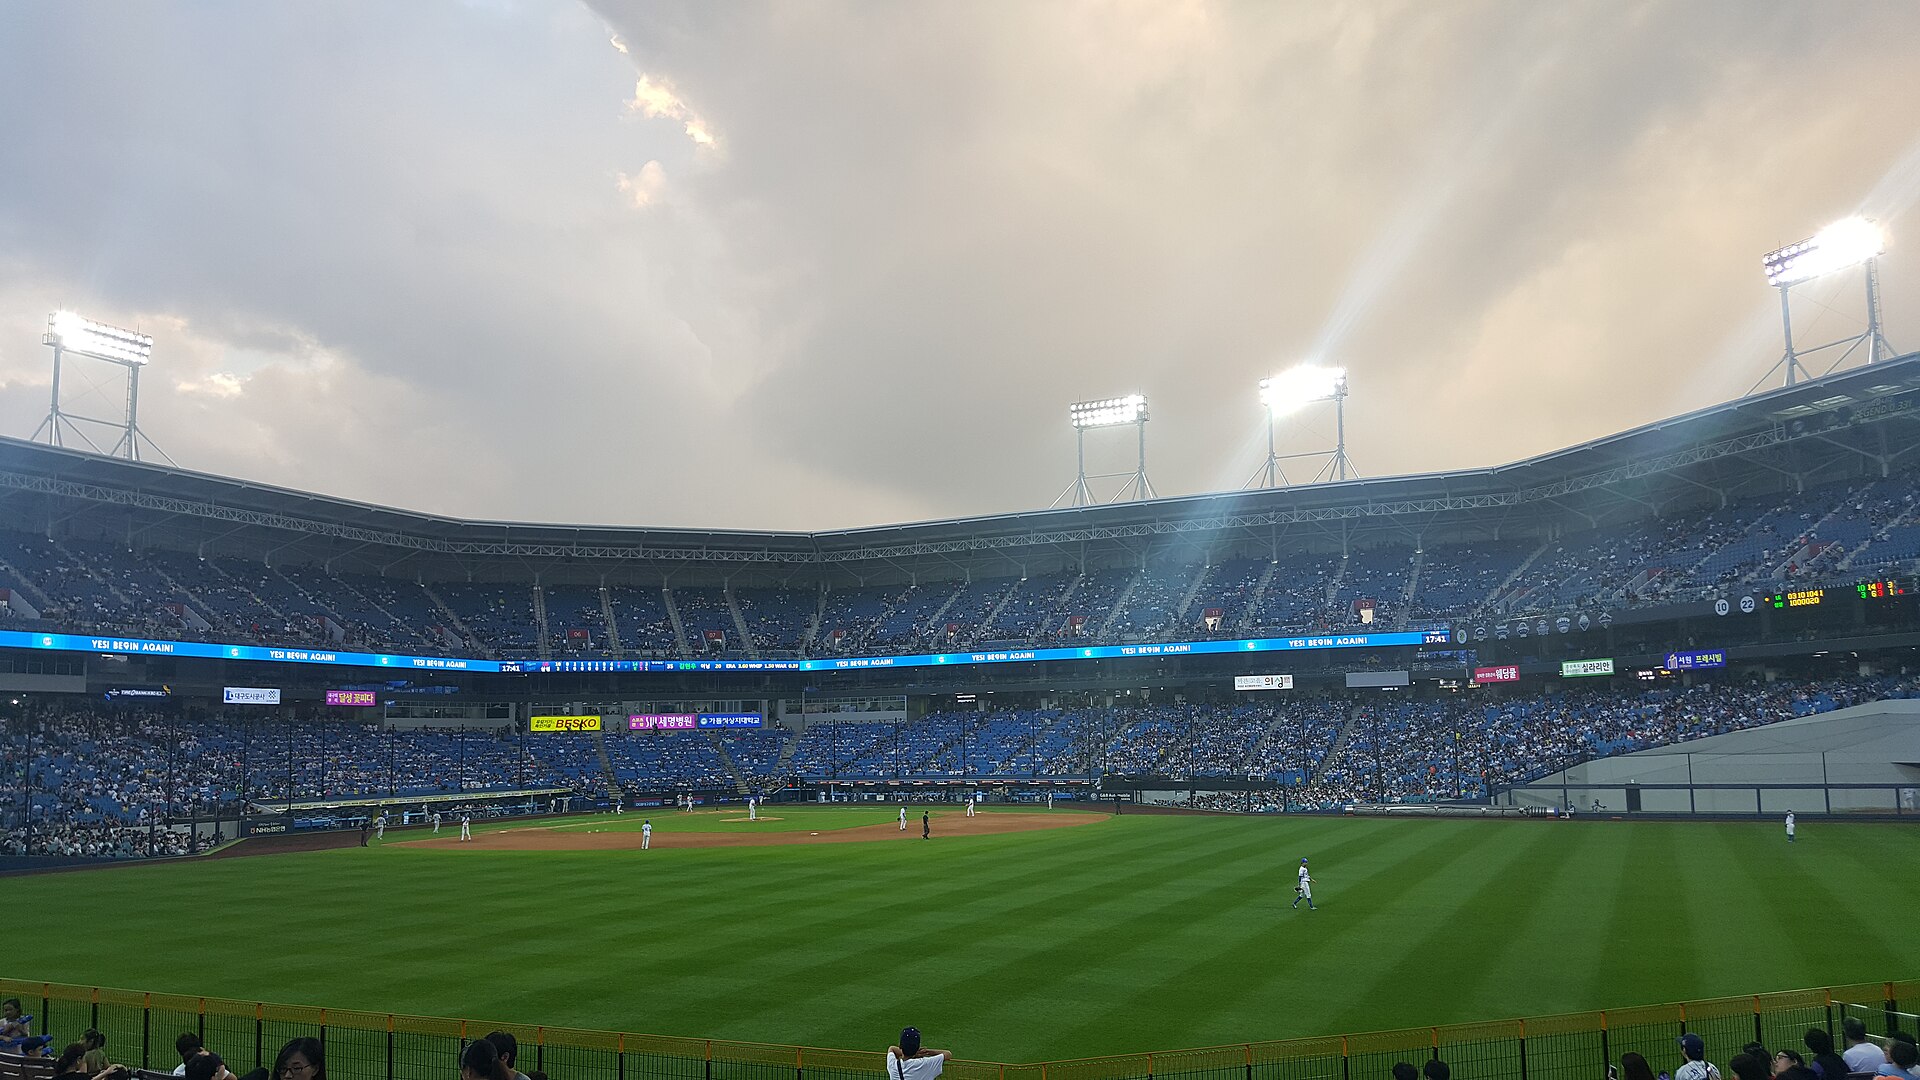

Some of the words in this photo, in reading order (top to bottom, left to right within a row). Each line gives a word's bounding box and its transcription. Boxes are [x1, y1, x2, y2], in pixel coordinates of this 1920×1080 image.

[1742, 600, 1753, 608] 22
[1582, 662, 1610, 672] 실라리안
[1265, 677, 1284, 688] 의성
[339, 692, 352, 703] 달성
[556, 719, 597, 728] BESKO
